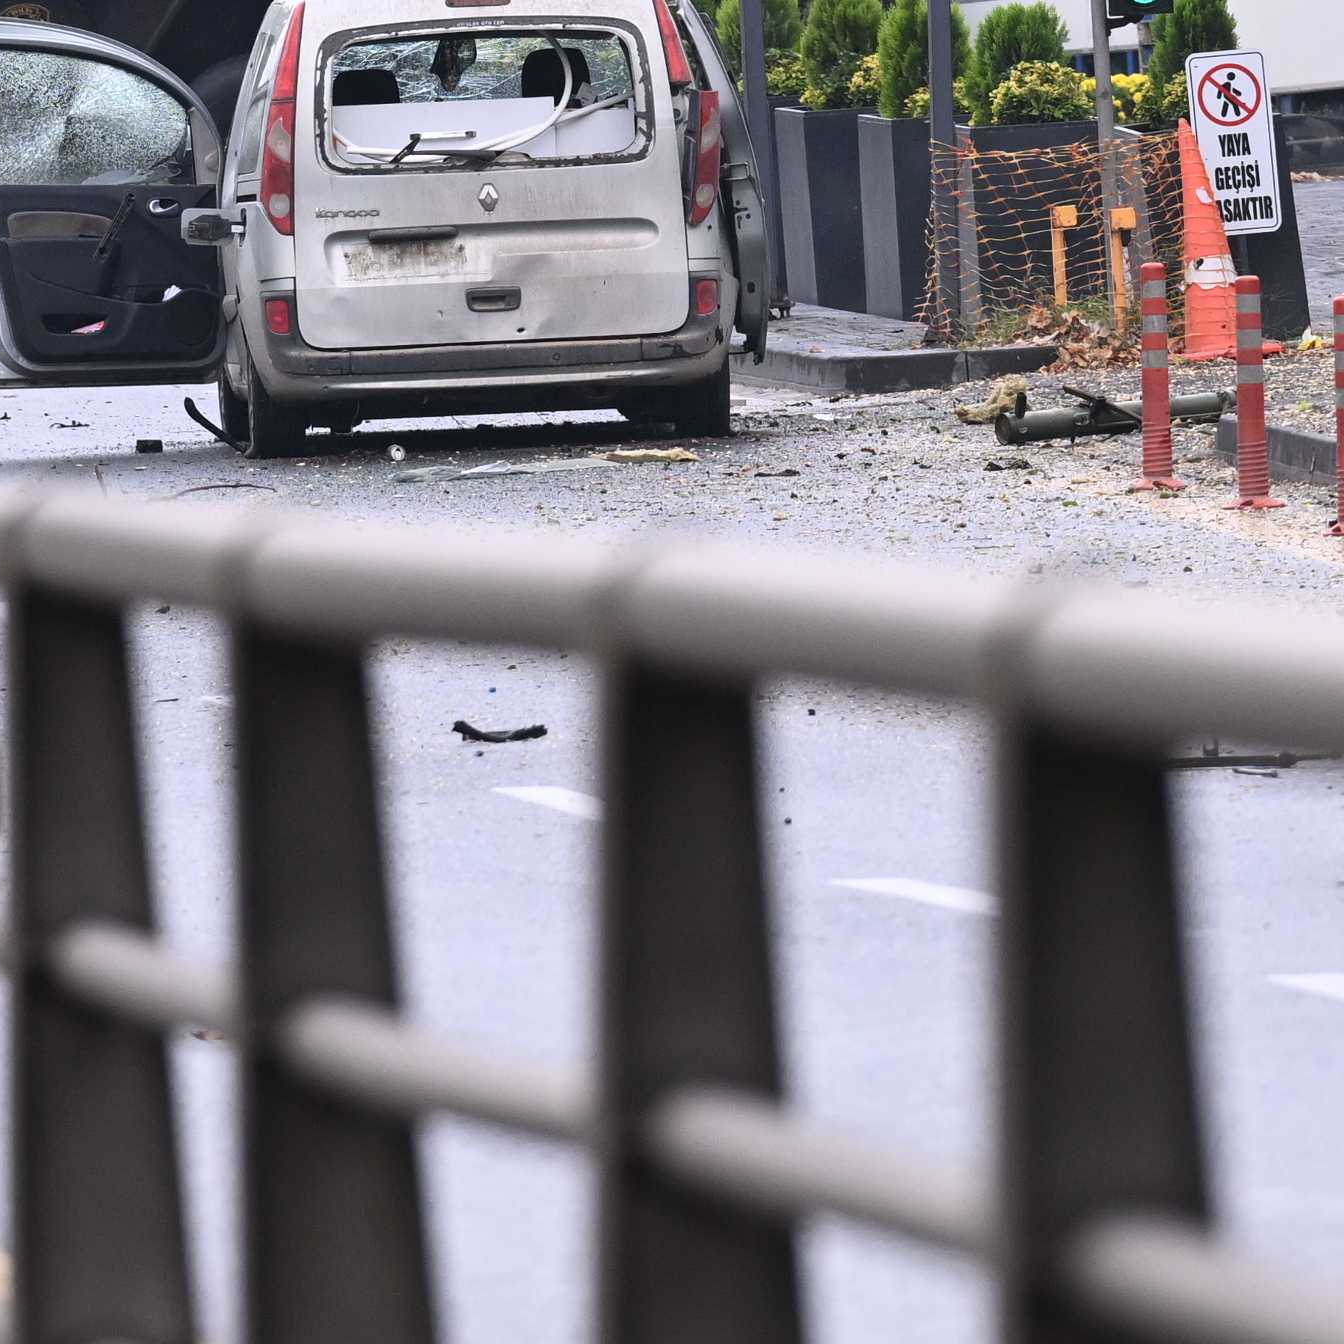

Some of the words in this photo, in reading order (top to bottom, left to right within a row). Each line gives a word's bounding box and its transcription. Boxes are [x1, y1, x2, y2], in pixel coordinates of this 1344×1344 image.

[1218, 132, 1251, 157] YAYA
[1214, 160, 1261, 193] GEÇİŞİ
[1215, 195, 1274, 223] ASAKTIR
